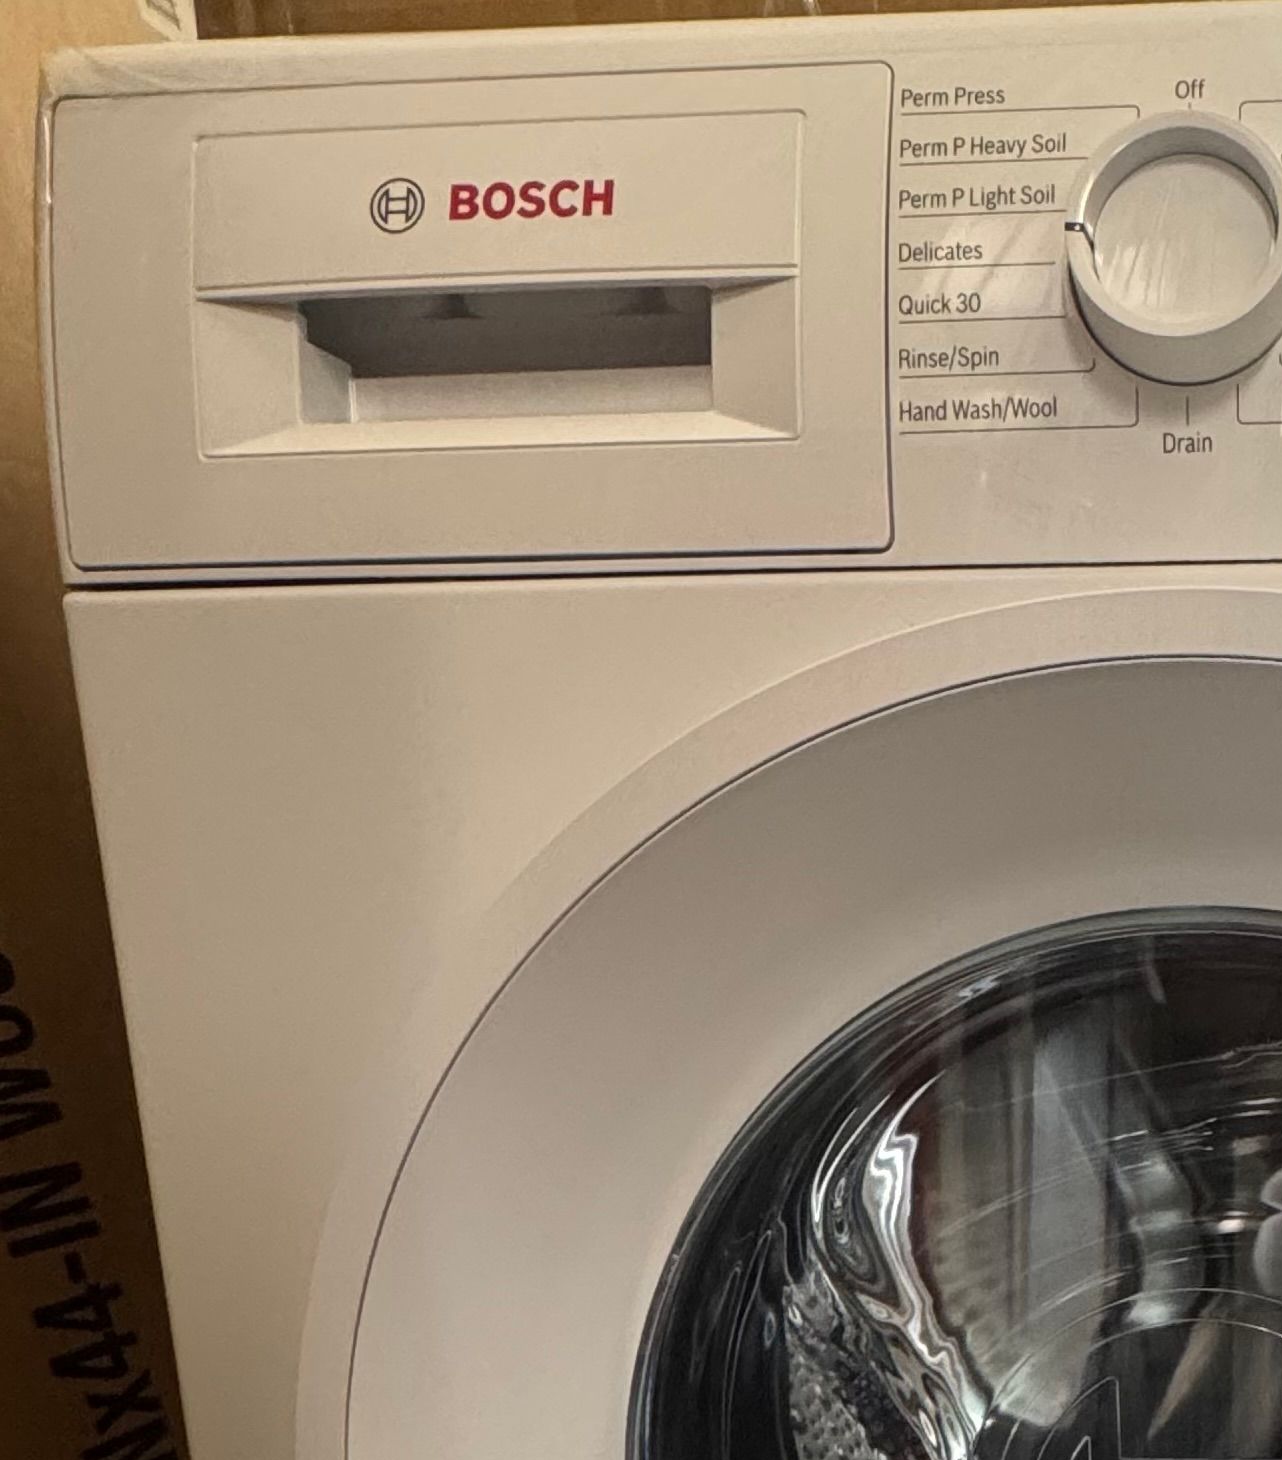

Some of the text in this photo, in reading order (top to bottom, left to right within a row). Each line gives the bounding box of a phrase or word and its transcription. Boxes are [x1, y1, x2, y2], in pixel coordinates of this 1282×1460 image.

[901, 87, 1005, 107] Perm Press
[1175, 79, 1205, 99] Off
[900, 133, 1067, 158] Perm P Heavy Soil
[449, 179, 615, 222] BOSCH
[899, 184, 1055, 210] Perm P Light Soil
[899, 241, 982, 263] Delicates
[899, 293, 981, 316] Quick 30
[899, 346, 999, 372] Rinse/Spin
[899, 396, 1057, 422] Hand Wash/Wool
[1163, 432, 1212, 454] Drain
